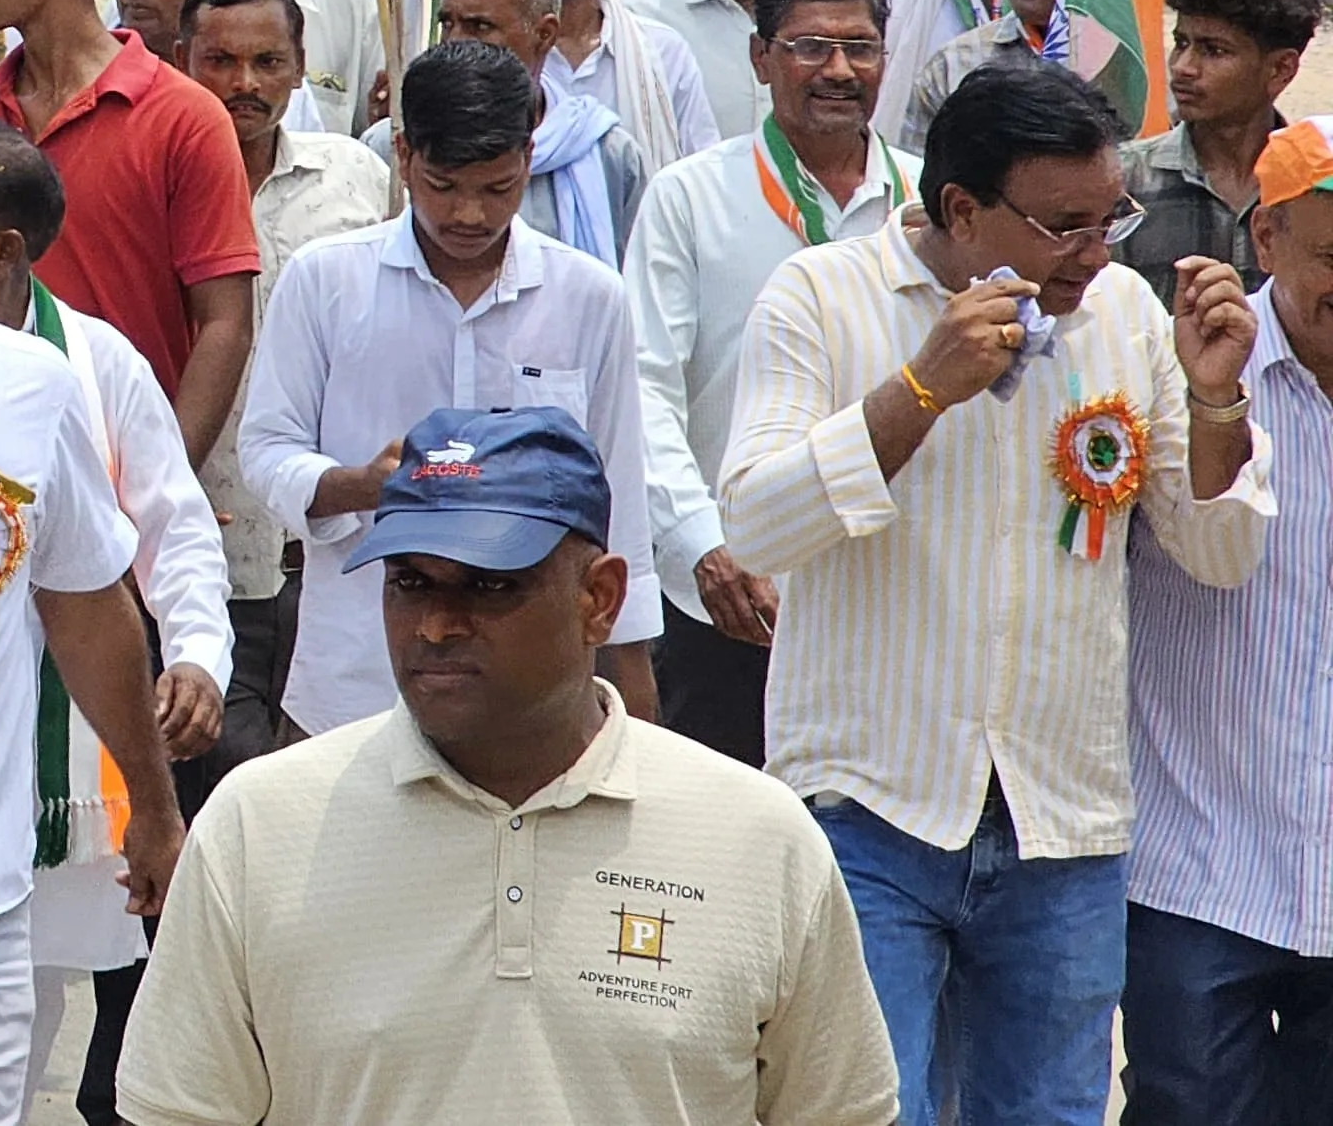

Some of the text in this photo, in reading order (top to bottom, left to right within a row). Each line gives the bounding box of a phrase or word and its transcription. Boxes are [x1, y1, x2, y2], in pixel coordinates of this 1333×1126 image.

[595, 870, 705, 901] GENERATION
[630, 920, 655, 950] P
[577, 970, 693, 1000] ADVENTURE FORT
[596, 987, 677, 1010] PERFECTION
